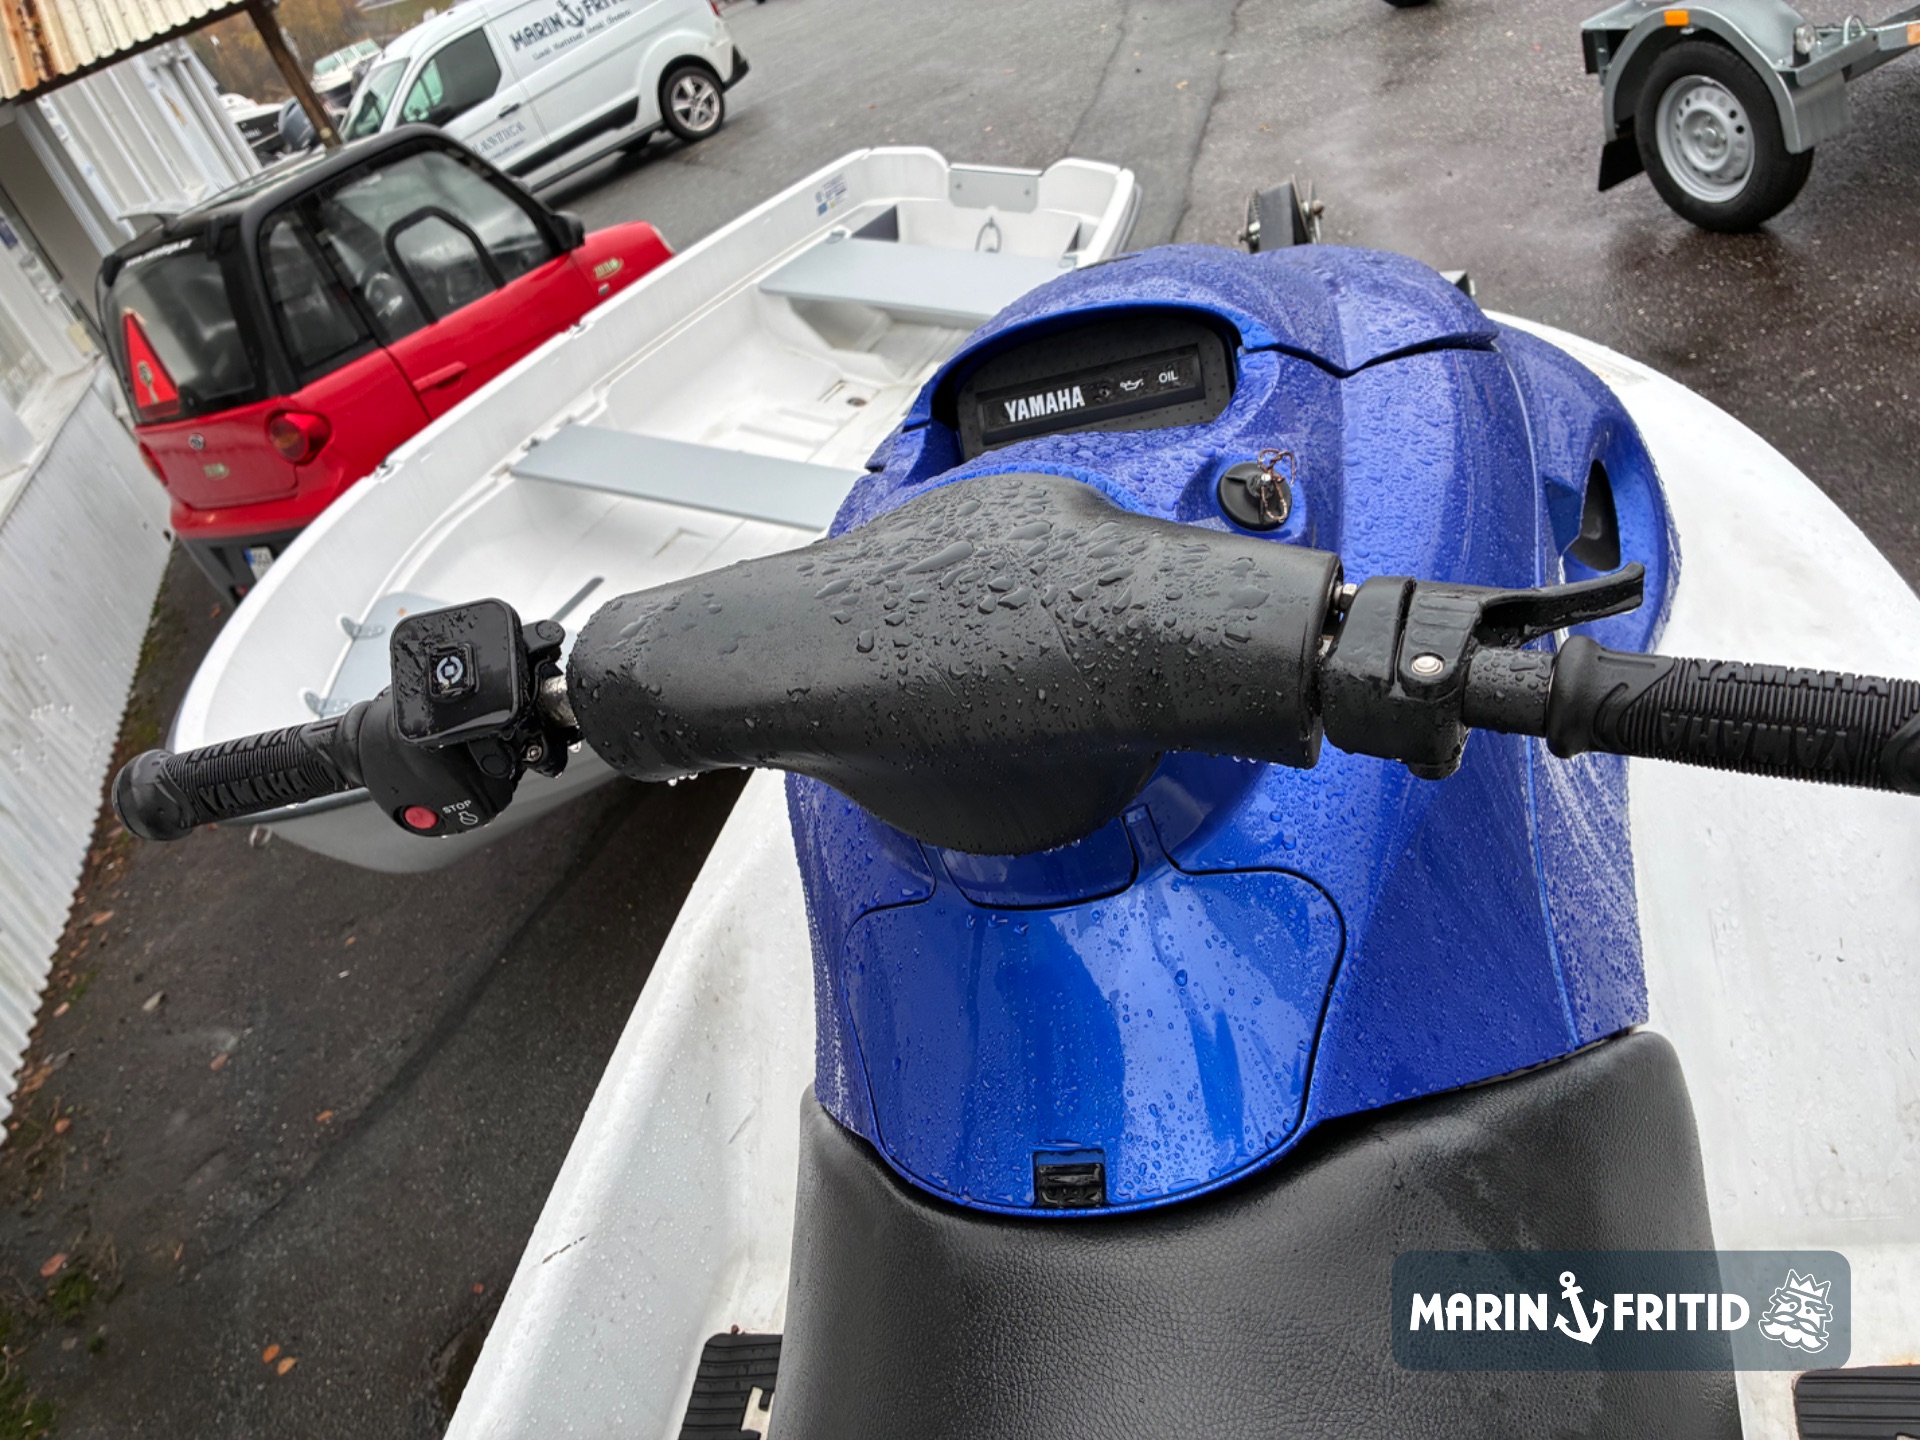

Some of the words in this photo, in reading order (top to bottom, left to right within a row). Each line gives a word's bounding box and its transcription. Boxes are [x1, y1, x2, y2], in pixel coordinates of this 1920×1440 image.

[509, 11, 565, 51] MARIN
[1004, 386, 1085, 423] YAMAHA
[1158, 370, 1179, 384] OIL
[1696, 659, 1889, 696] YAMAHA
[201, 768, 310, 816] YAMAHA
[442, 799, 472, 814] STOP
